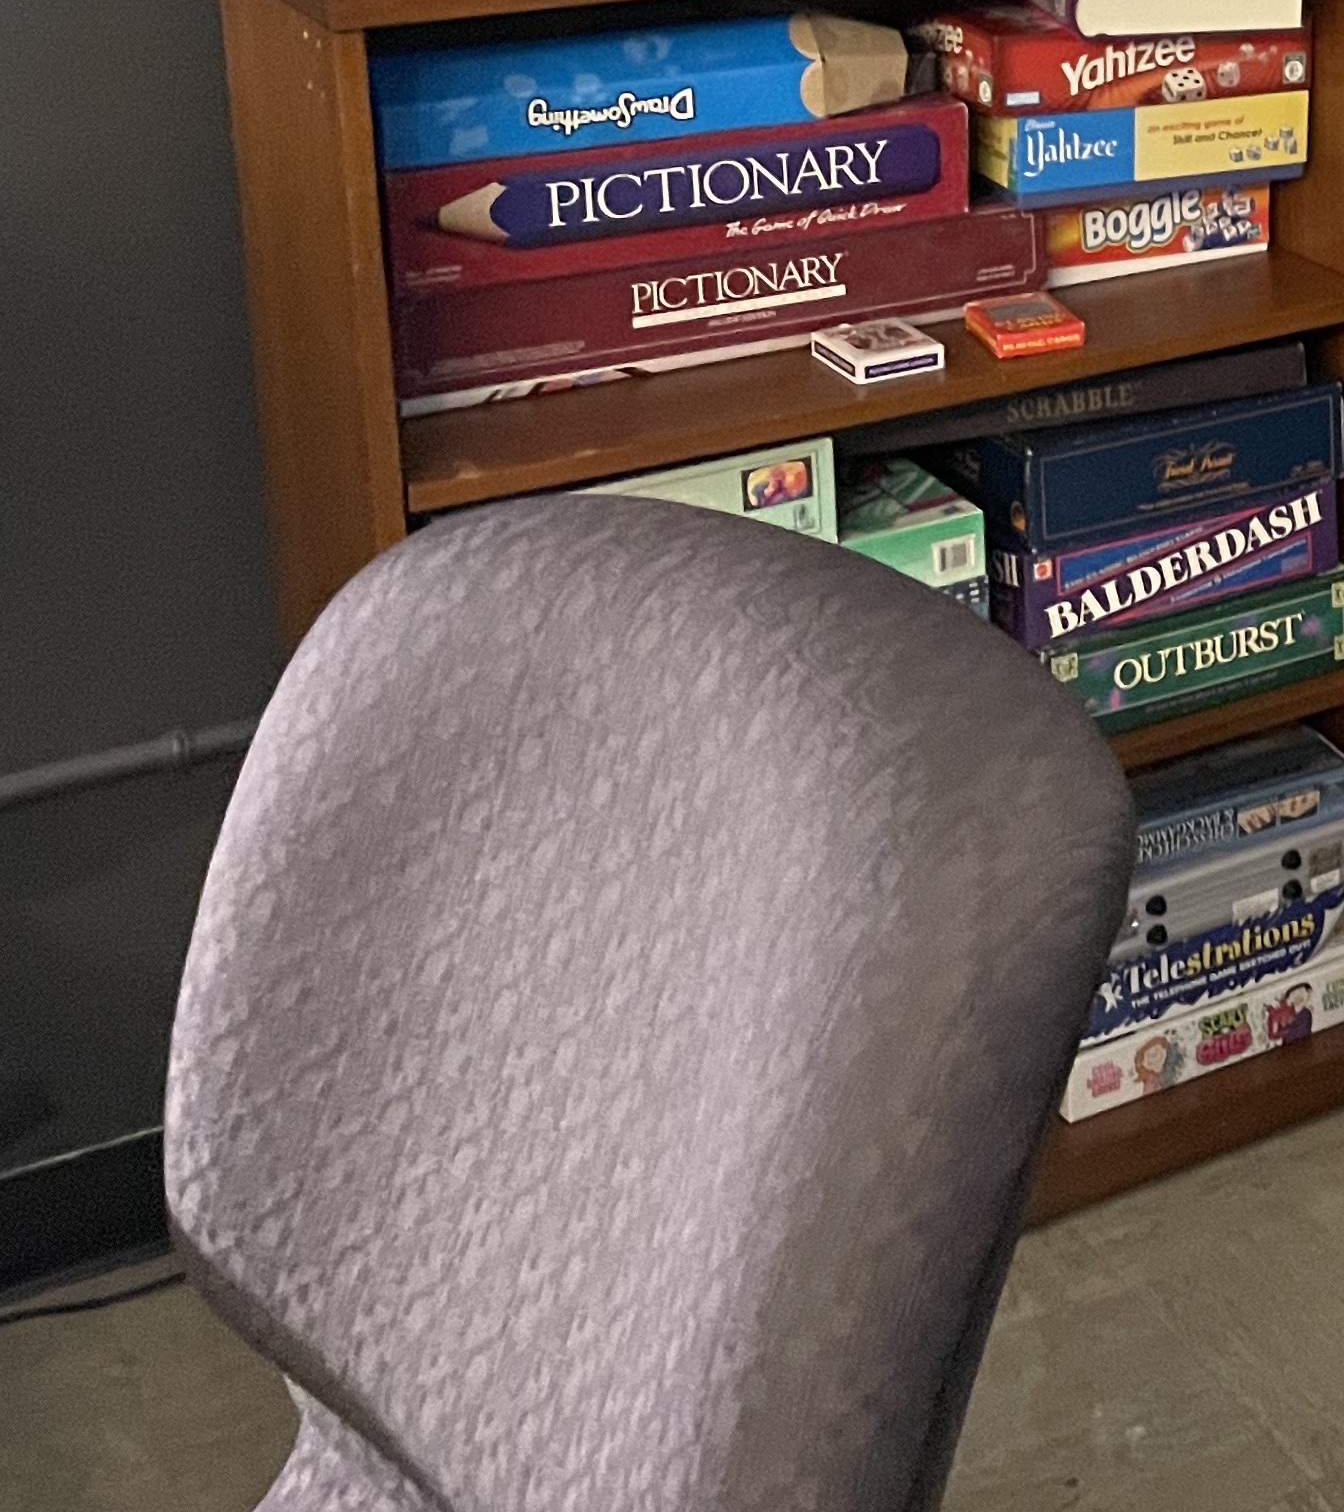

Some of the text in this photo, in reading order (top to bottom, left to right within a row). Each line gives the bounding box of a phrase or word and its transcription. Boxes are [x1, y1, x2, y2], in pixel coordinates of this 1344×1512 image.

[1061, 36, 1196, 97] Yahtzee
[546, 139, 890, 228] PICTIONARY
[1023, 127, 1118, 178] Yahtzee
[726, 221, 748, 238] The
[752, 218, 794, 236] Game
[797, 210, 818, 230] of
[816, 205, 858, 225] Quick
[1083, 188, 1203, 251] Boggle
[631, 251, 844, 315] PICTIONARY
[1006, 384, 1134, 423] SCRABBLE
[1044, 492, 1324, 640] BALDERDASH
[1113, 612, 1303, 691] OUTBURST
[1129, 912, 1316, 995] Telestrations
